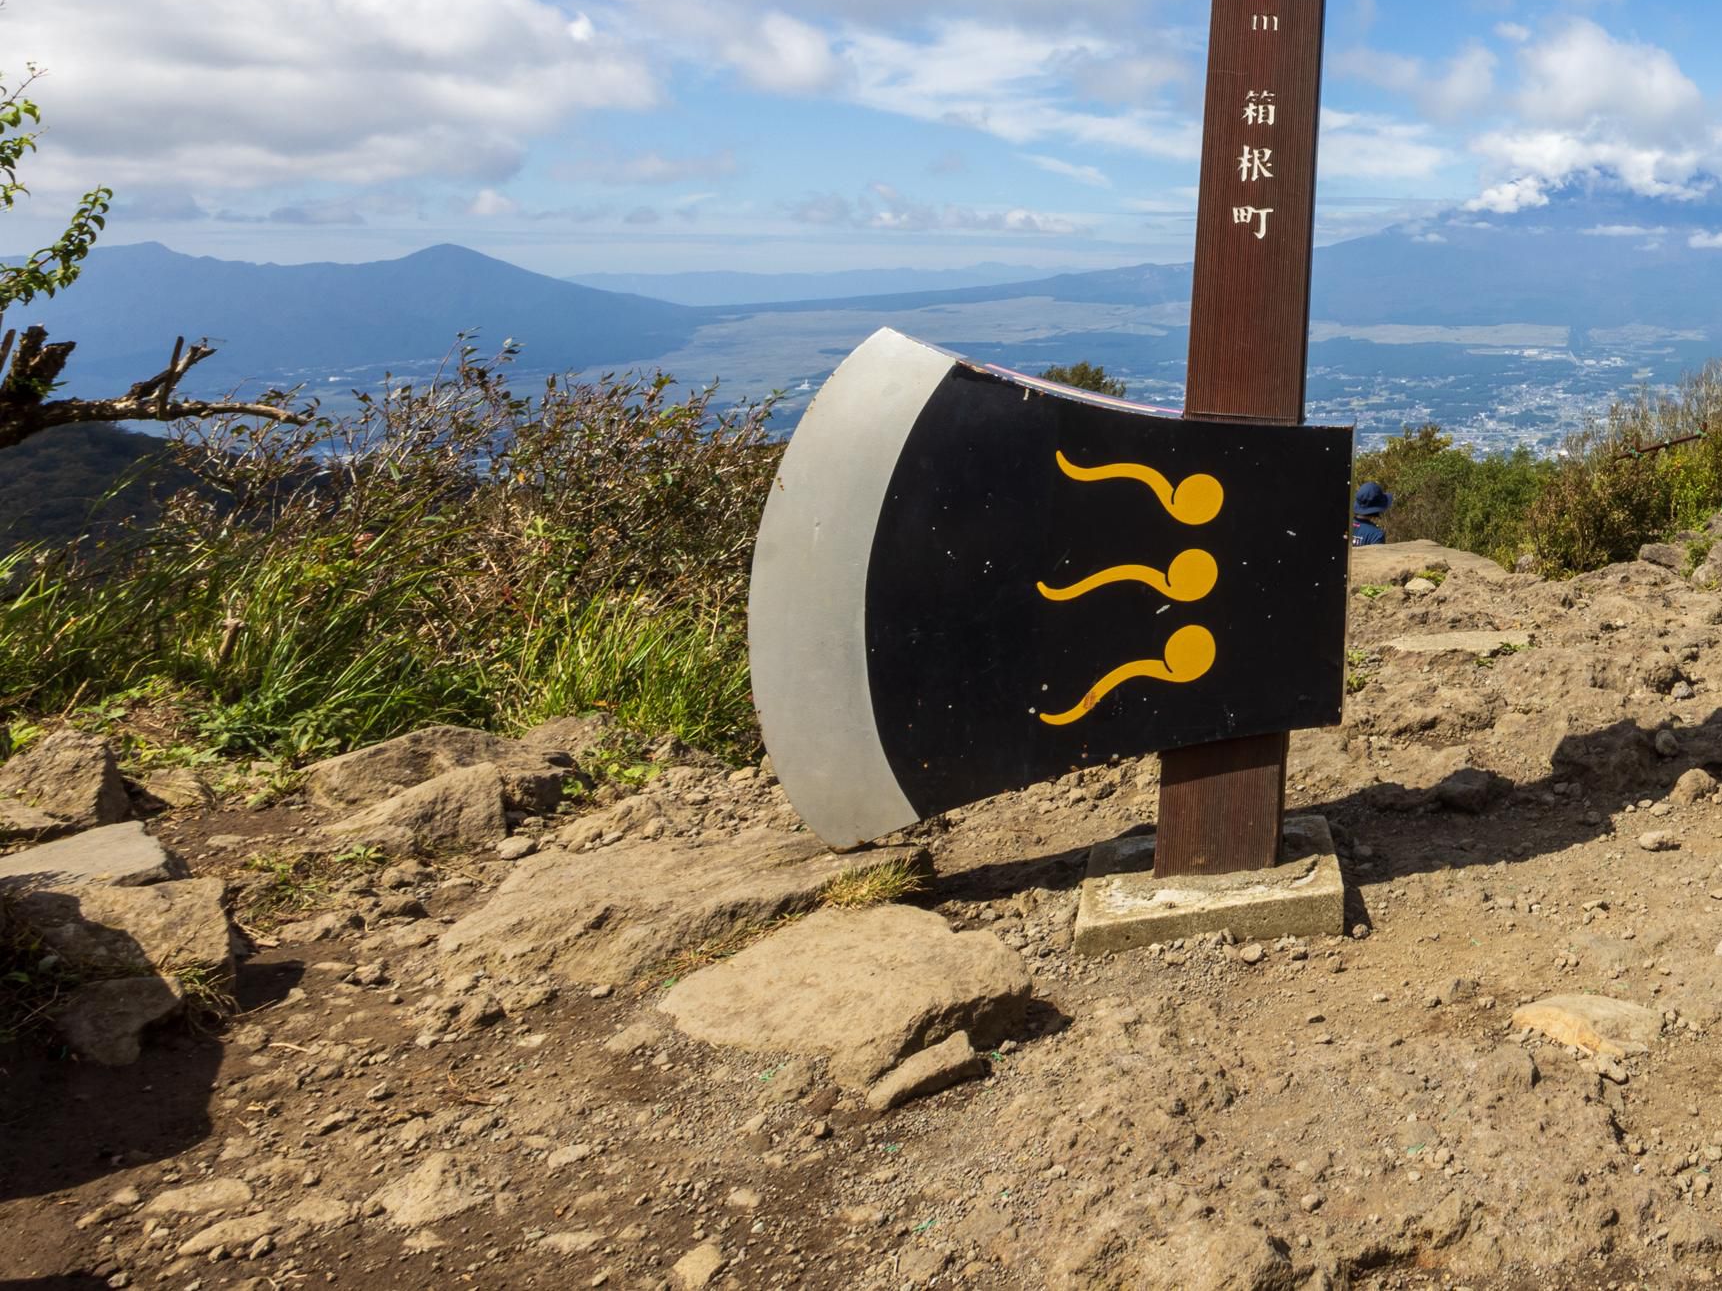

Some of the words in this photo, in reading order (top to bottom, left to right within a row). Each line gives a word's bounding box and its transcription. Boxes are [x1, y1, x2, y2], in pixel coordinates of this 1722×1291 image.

[1252, 14, 1279, 31] m
[1232, 90, 1275, 240] 箱根町
